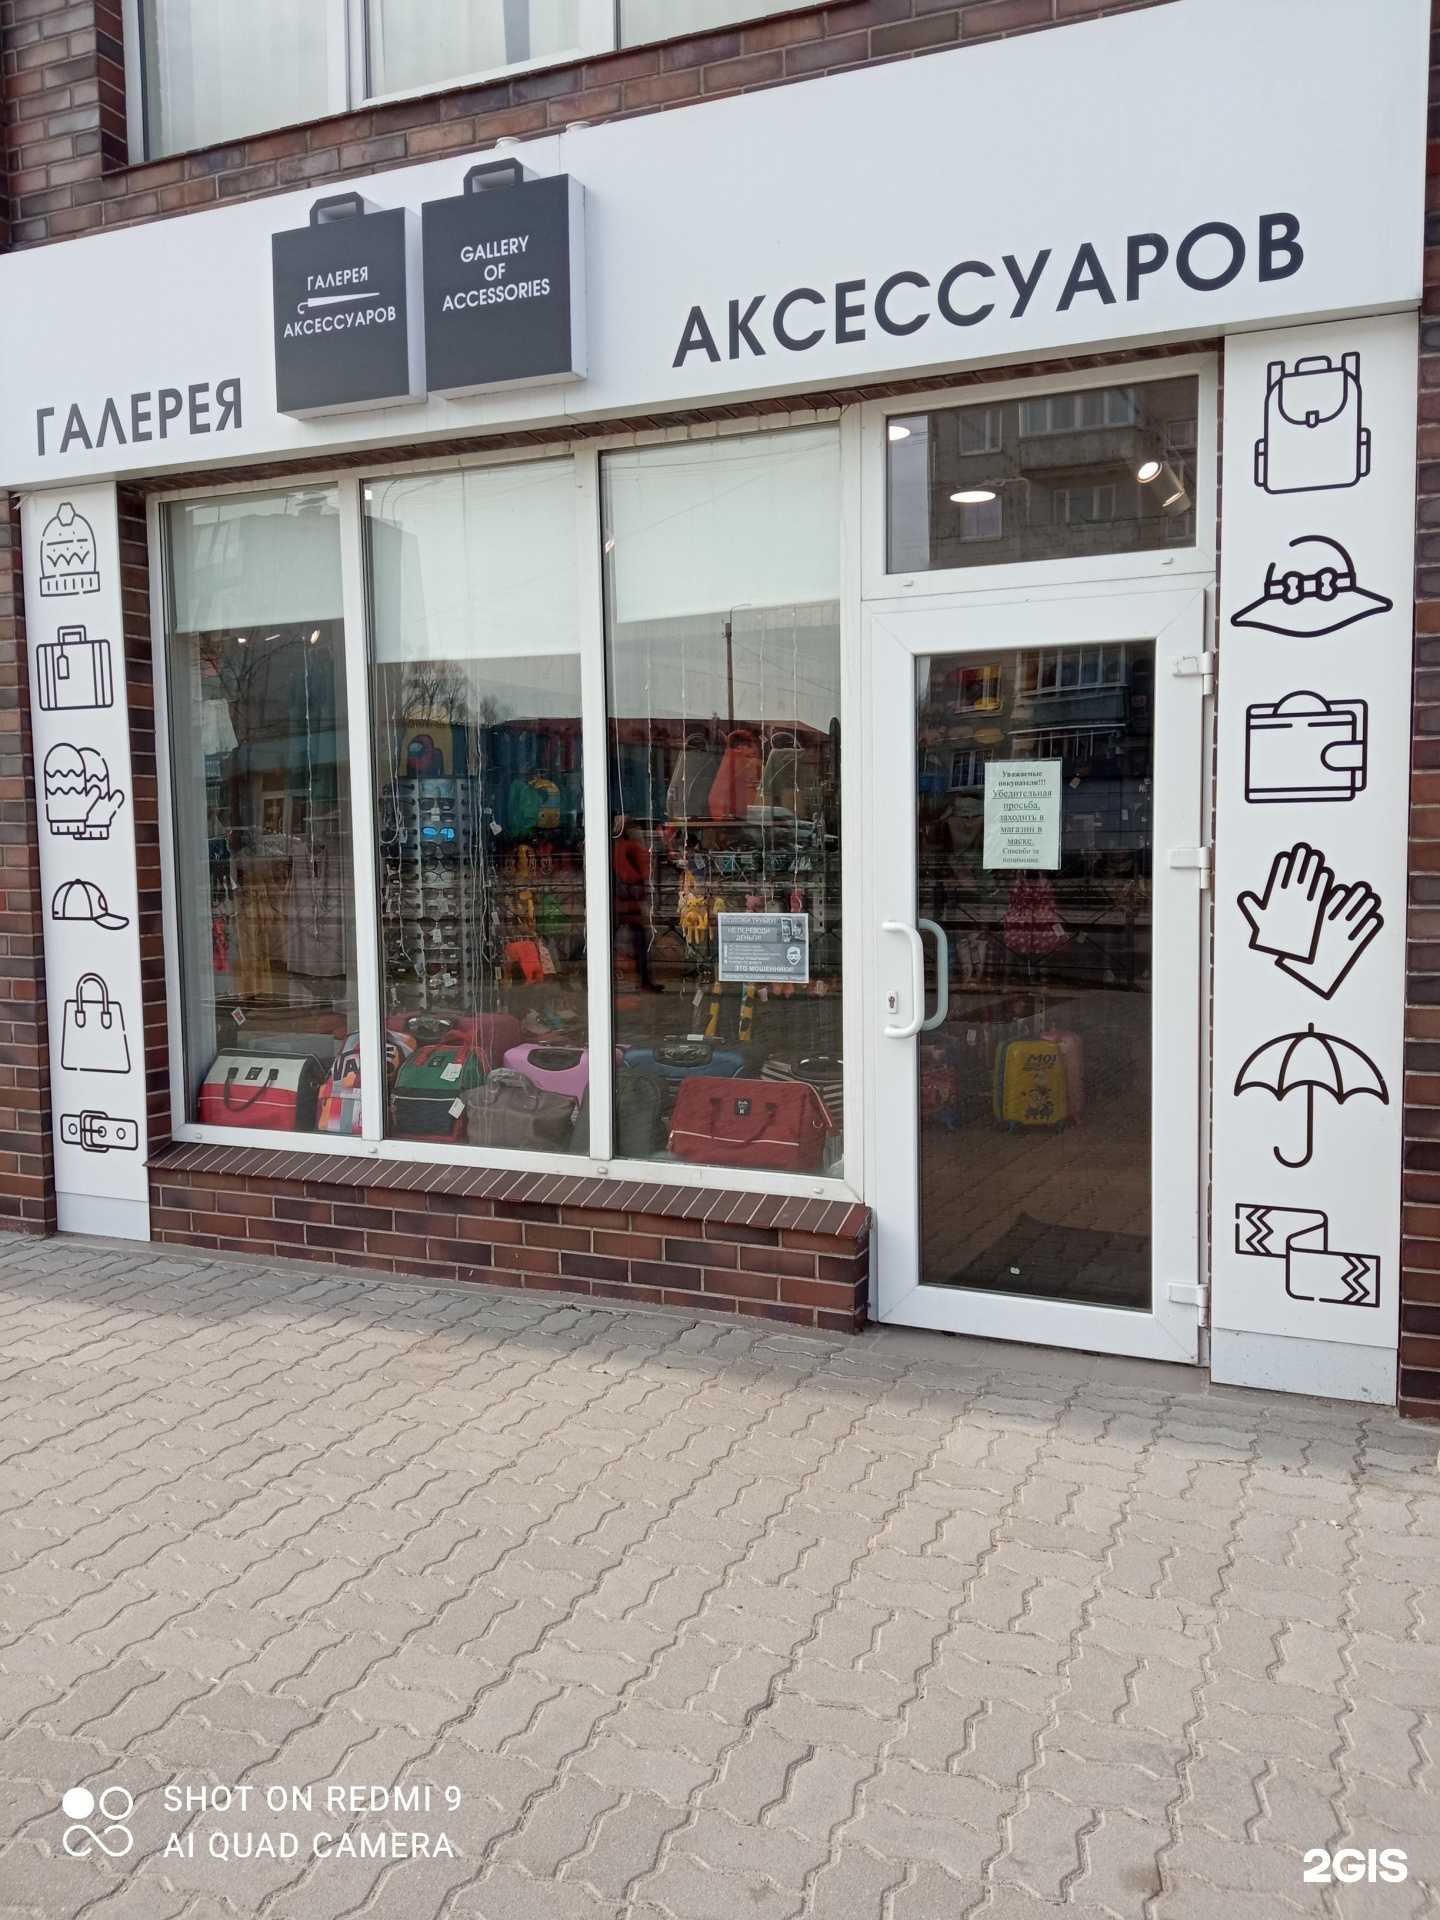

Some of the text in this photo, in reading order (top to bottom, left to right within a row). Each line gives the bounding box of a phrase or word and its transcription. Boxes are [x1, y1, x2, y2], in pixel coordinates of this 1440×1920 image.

[460, 235, 529, 263] GALLERY
[307, 266, 369, 291] ГАЛЕРЕЯ
[483, 262, 506, 282] OF
[442, 278, 551, 312] ACCESSORIES
[671, 212, 1304, 369] АКСЕССУАРОВ
[283, 306, 396, 339] АКСЕССУАРОВ
[36, 377, 242, 457] ГАЛЕРЕЯ
[992, 789, 1052, 799] Убедительная
